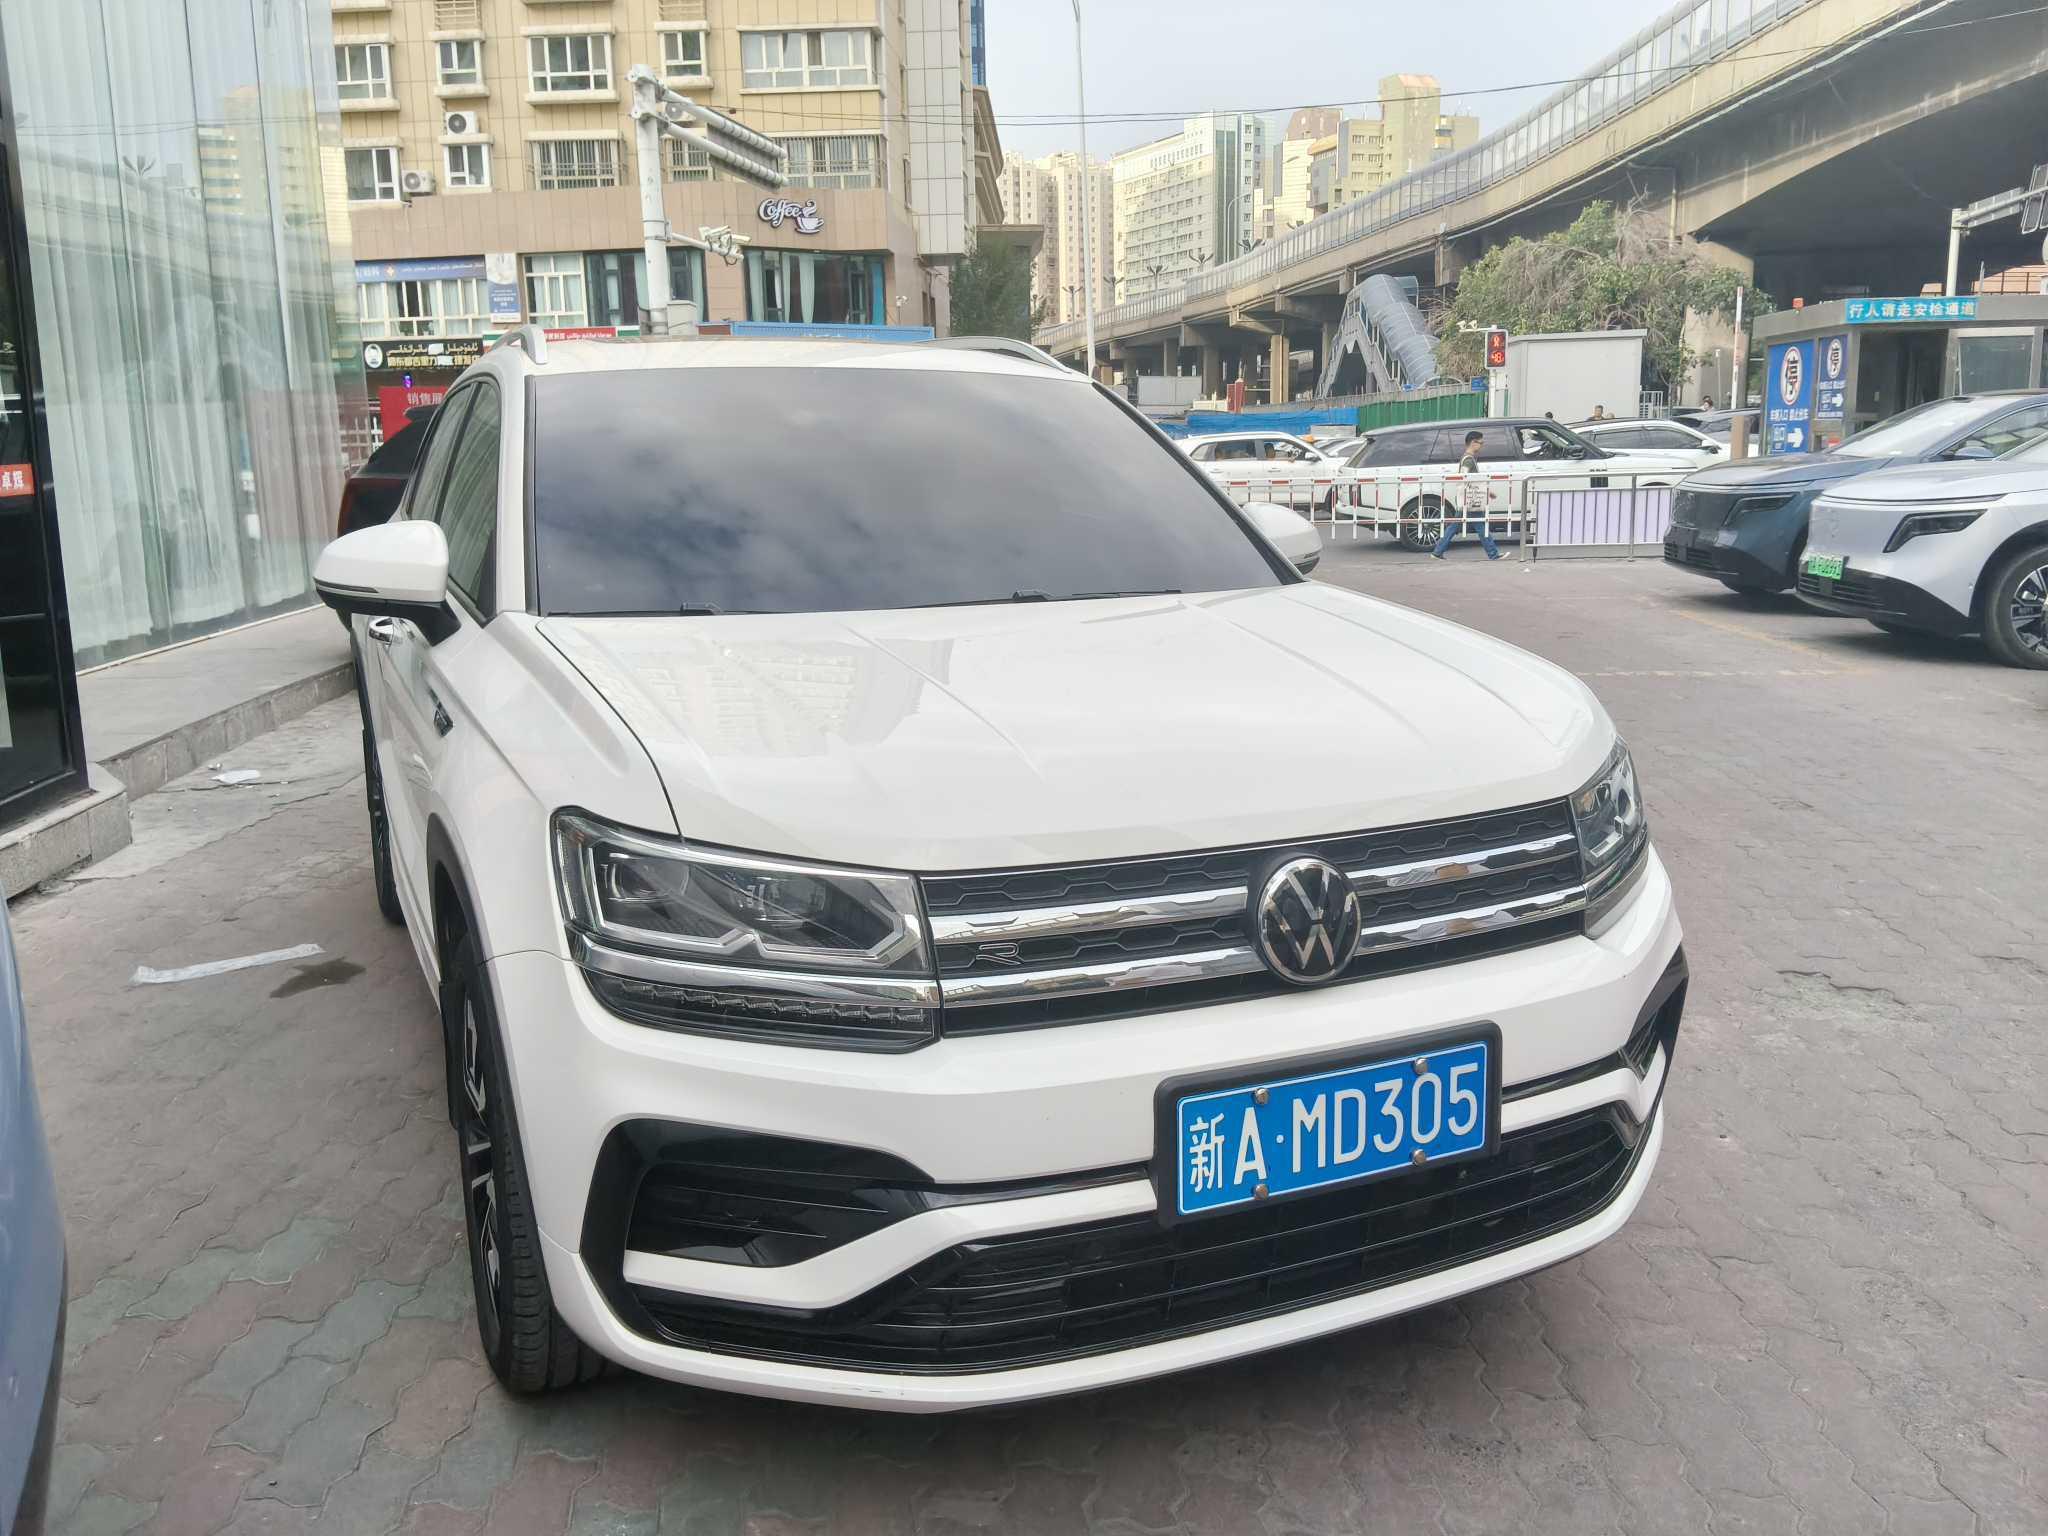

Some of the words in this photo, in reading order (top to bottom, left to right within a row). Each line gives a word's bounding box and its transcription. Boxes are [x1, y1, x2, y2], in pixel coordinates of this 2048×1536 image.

[758, 199, 802, 228] Coffee
[1849, 302, 1975, 318] 行人请走安检通道
